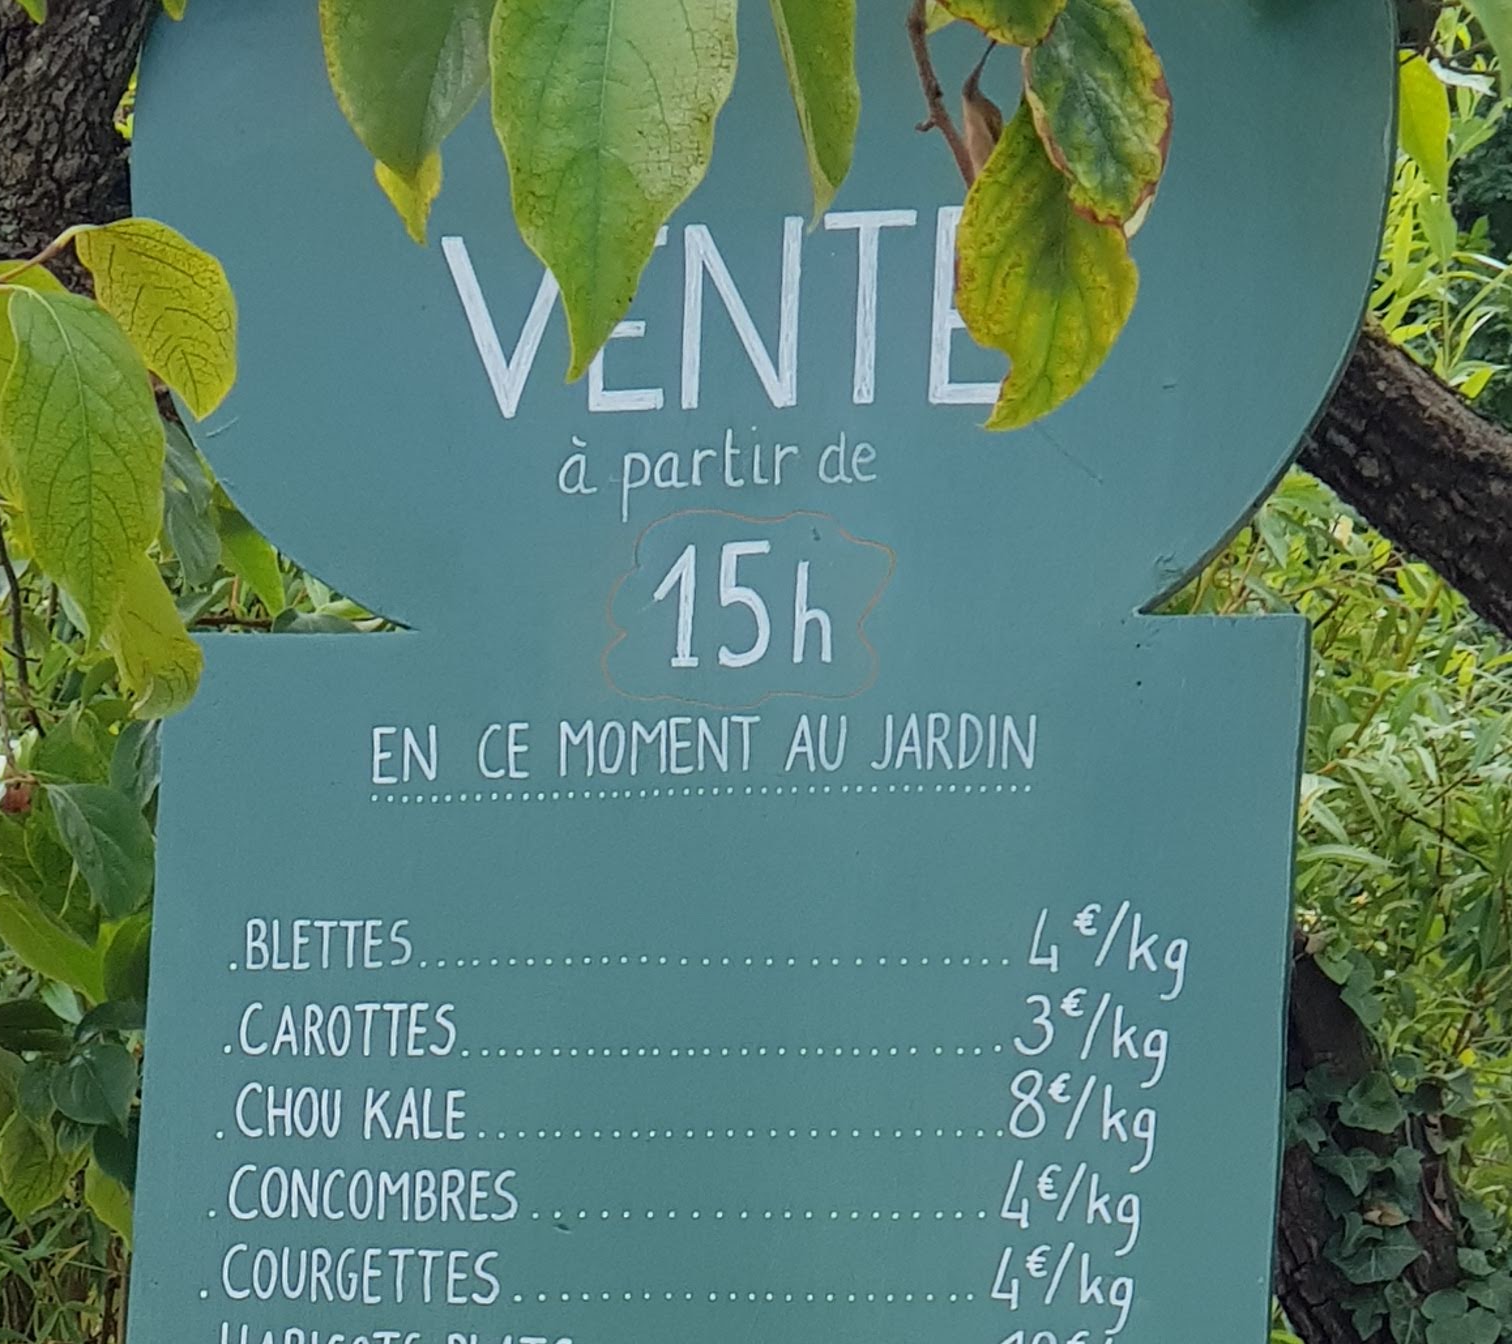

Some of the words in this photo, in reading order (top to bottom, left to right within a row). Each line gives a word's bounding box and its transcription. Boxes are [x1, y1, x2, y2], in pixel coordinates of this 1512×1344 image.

[558, 435, 598, 494] à
[622, 425, 799, 523] partir
[818, 431, 877, 484] de
[653, 540, 832, 668] 15h
[372, 724, 437, 784] EN
[478, 722, 530, 779] CE
[559, 715, 761, 777] MOMENT
[784, 714, 847, 772] AU
[870, 712, 1037, 770] JARDIN
[246, 918, 412, 970] BLETTES
[1028, 900, 1188, 1001] 4€/kg
[239, 1002, 457, 1057] CAROTTES
[1013, 987, 1168, 1089] 3€/kg
[235, 1082, 342, 1138] CHOU
[363, 1087, 466, 1140] KALE
[1009, 1069, 1156, 1174] 8€/kg
[228, 1164, 518, 1222] CONCOMBRES
[1000, 1159, 1140, 1257] 4€/kg
[222, 1243, 500, 1305] COURGETTES
[990, 1241, 1134, 1335] 4€/kg
